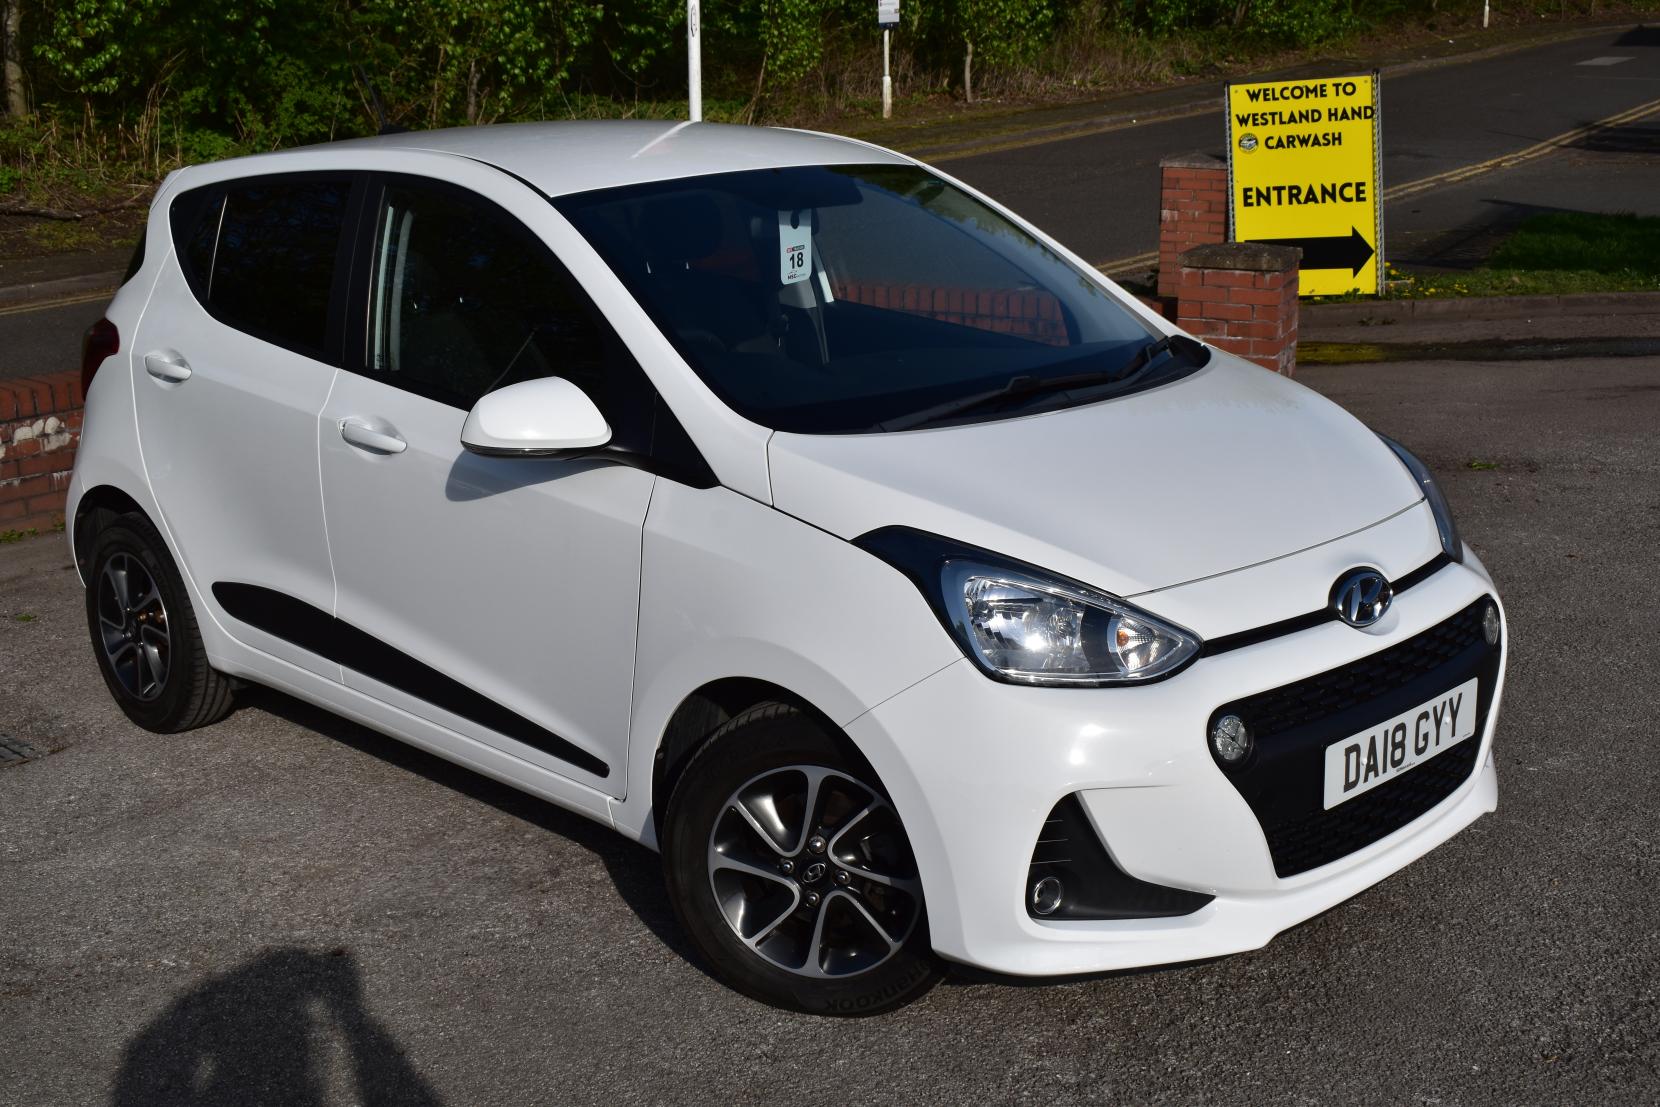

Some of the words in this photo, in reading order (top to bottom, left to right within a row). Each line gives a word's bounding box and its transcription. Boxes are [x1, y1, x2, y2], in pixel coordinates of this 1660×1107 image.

[1246, 84, 1327, 102] WELCOME
[1332, 82, 1357, 97] TO
[1236, 109, 1322, 127] WESTLAND
[1327, 106, 1375, 122] HAND
[1264, 132, 1342, 150] CARWASH
[1242, 182, 1367, 207] ENTRANCE
[789, 251, 804, 269] 18
[1343, 722, 1407, 793] DA18
[1414, 693, 1463, 757] GYY
